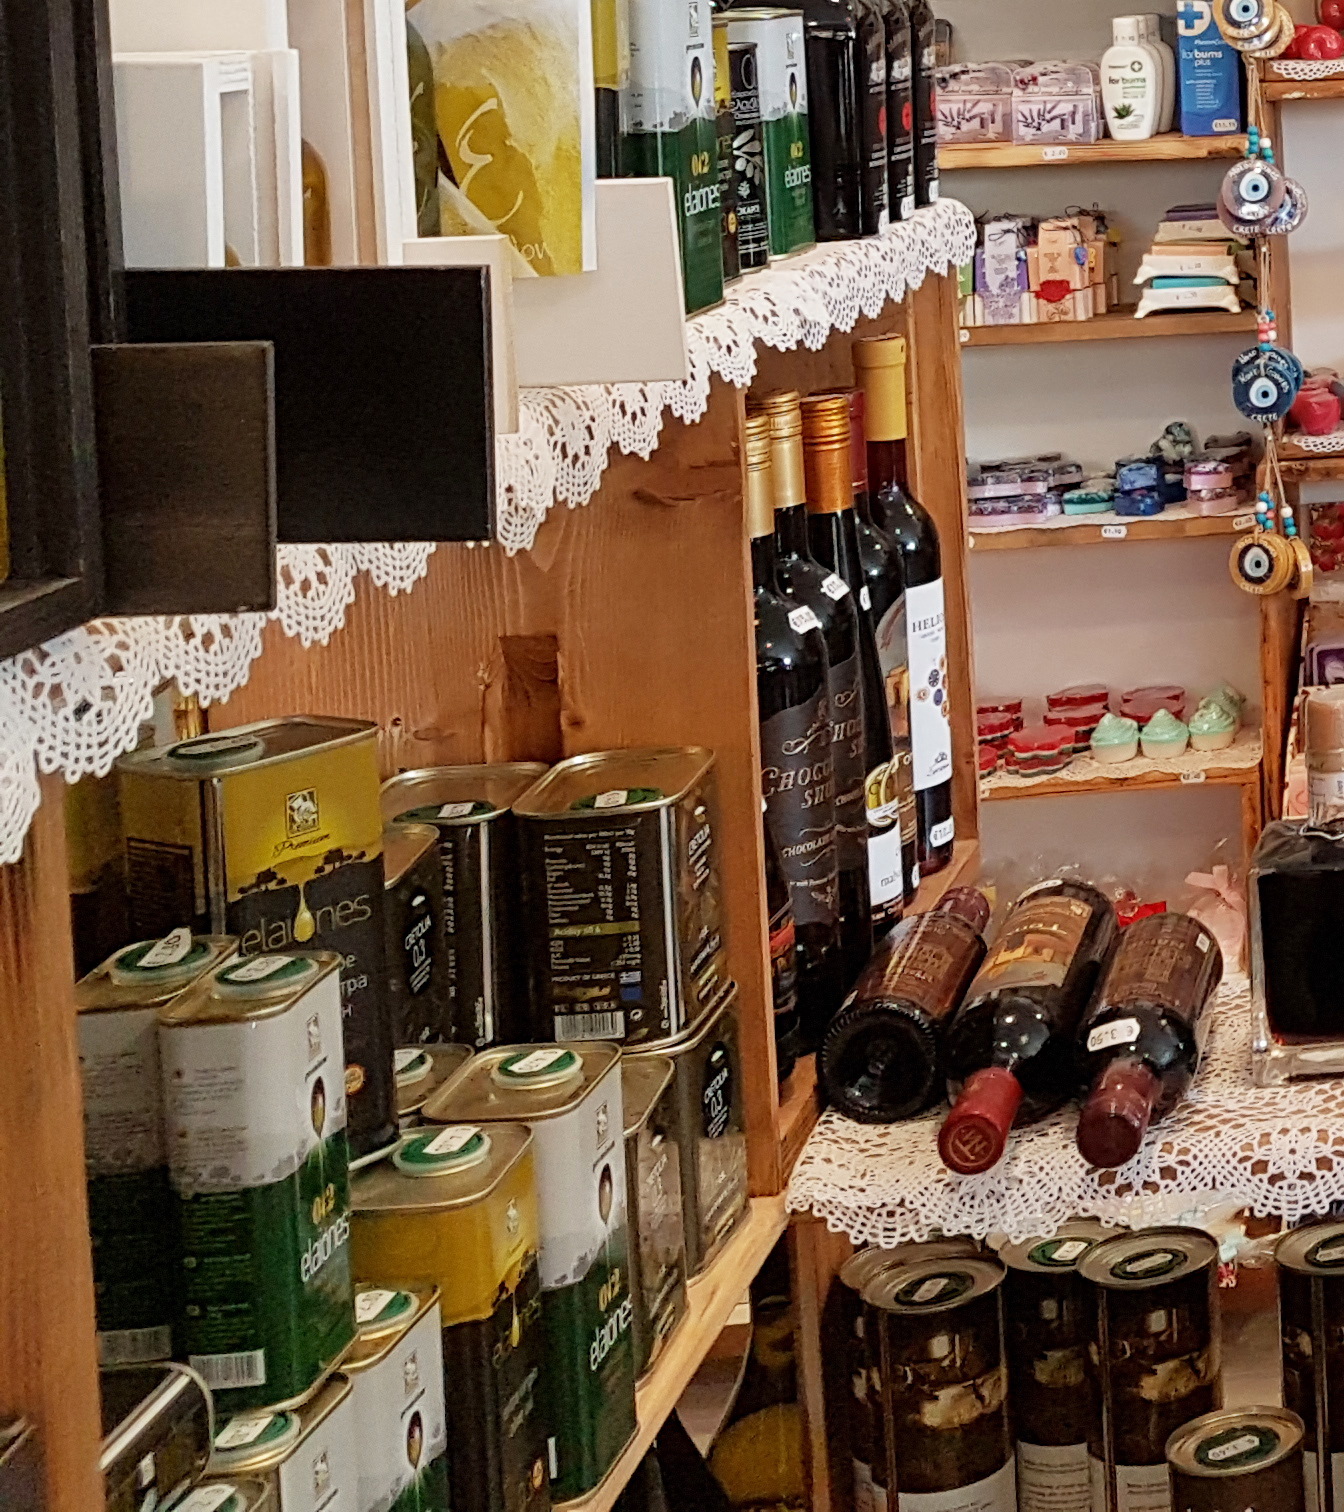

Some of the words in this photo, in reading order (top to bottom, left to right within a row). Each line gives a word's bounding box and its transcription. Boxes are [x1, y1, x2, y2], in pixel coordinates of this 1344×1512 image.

[1194, 50, 1222, 59] burns
[1194, 59, 1211, 67] plus
[1108, 76, 1120, 85] for
[1121, 76, 1146, 84] burns
[1233, 225, 1259, 233] CRETE
[1251, 413, 1278, 422] CRETE
[272, 832, 331, 858] Premium
